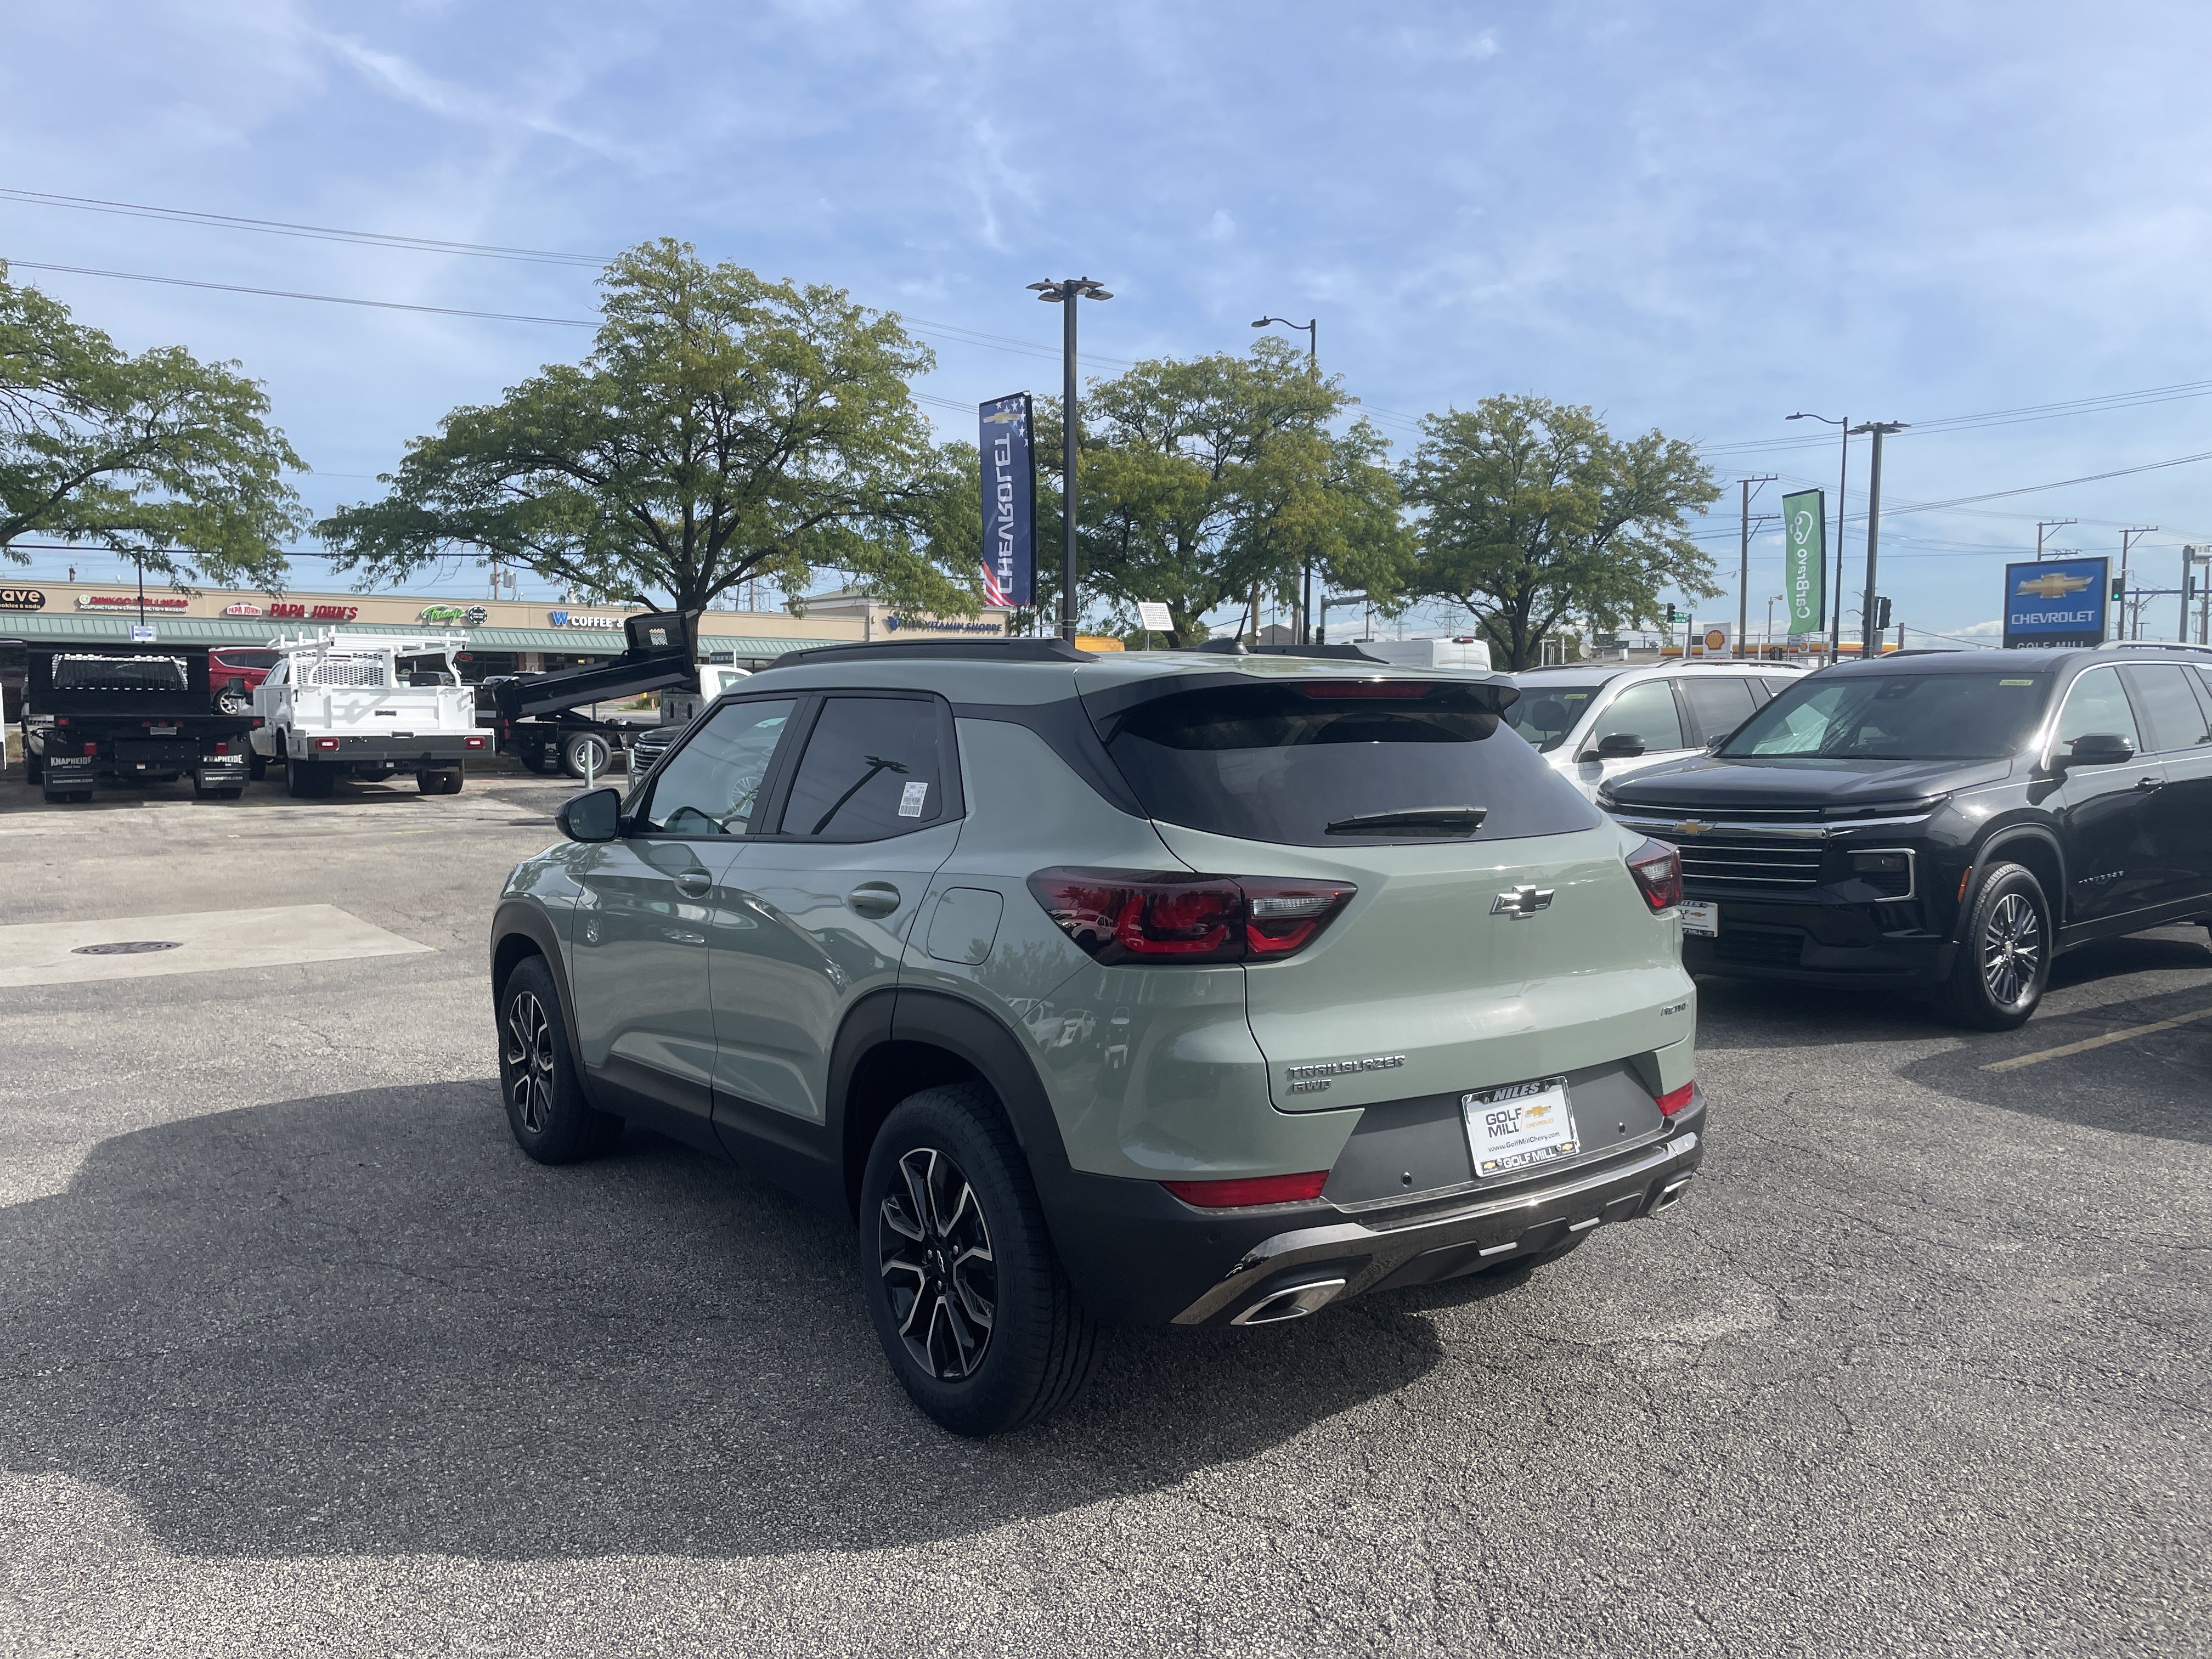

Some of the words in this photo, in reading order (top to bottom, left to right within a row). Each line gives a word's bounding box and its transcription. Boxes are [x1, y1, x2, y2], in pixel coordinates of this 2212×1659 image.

[0, 590, 40, 602] ave
[268, 603, 305, 618] PAPA
[311, 605, 358, 620] JOHN'S
[552, 610, 569, 625] W
[571, 616, 613, 628] COFFEE
[2011, 611, 2095, 625] CHEVROLET
[1290, 1055, 1406, 1079] TRAILBLAZER
[1293, 1079, 1332, 1092] AWD
[1492, 1082, 1540, 1102] NILES
[1486, 1107, 1522, 1126] GOLF
[1488, 1121, 1520, 1138] MILL
[1488, 1131, 1560, 1152] www.GolfMillChevy.com
[1503, 1153, 1531, 1169] GOLF
[1532, 1147, 1558, 1162] MILL
